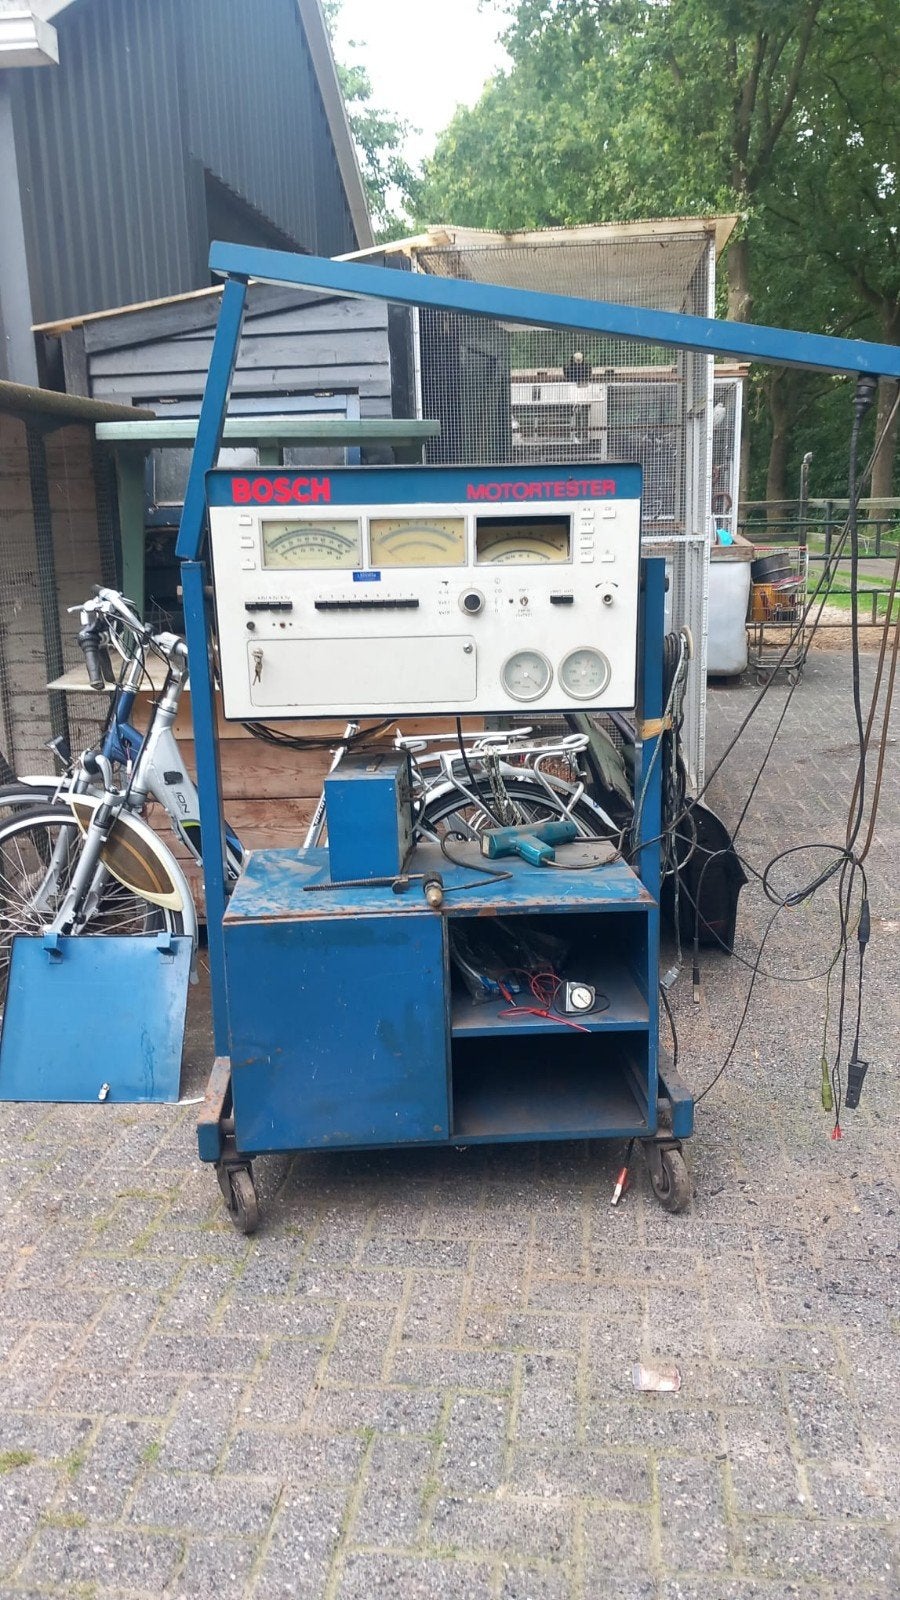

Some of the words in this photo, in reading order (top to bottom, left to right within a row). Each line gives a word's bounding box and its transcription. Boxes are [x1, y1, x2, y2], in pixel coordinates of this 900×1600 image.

[232, 477, 331, 503] BOSCH
[467, 479, 616, 500] MOTORTESTER
[175, 792, 190, 813] ION
